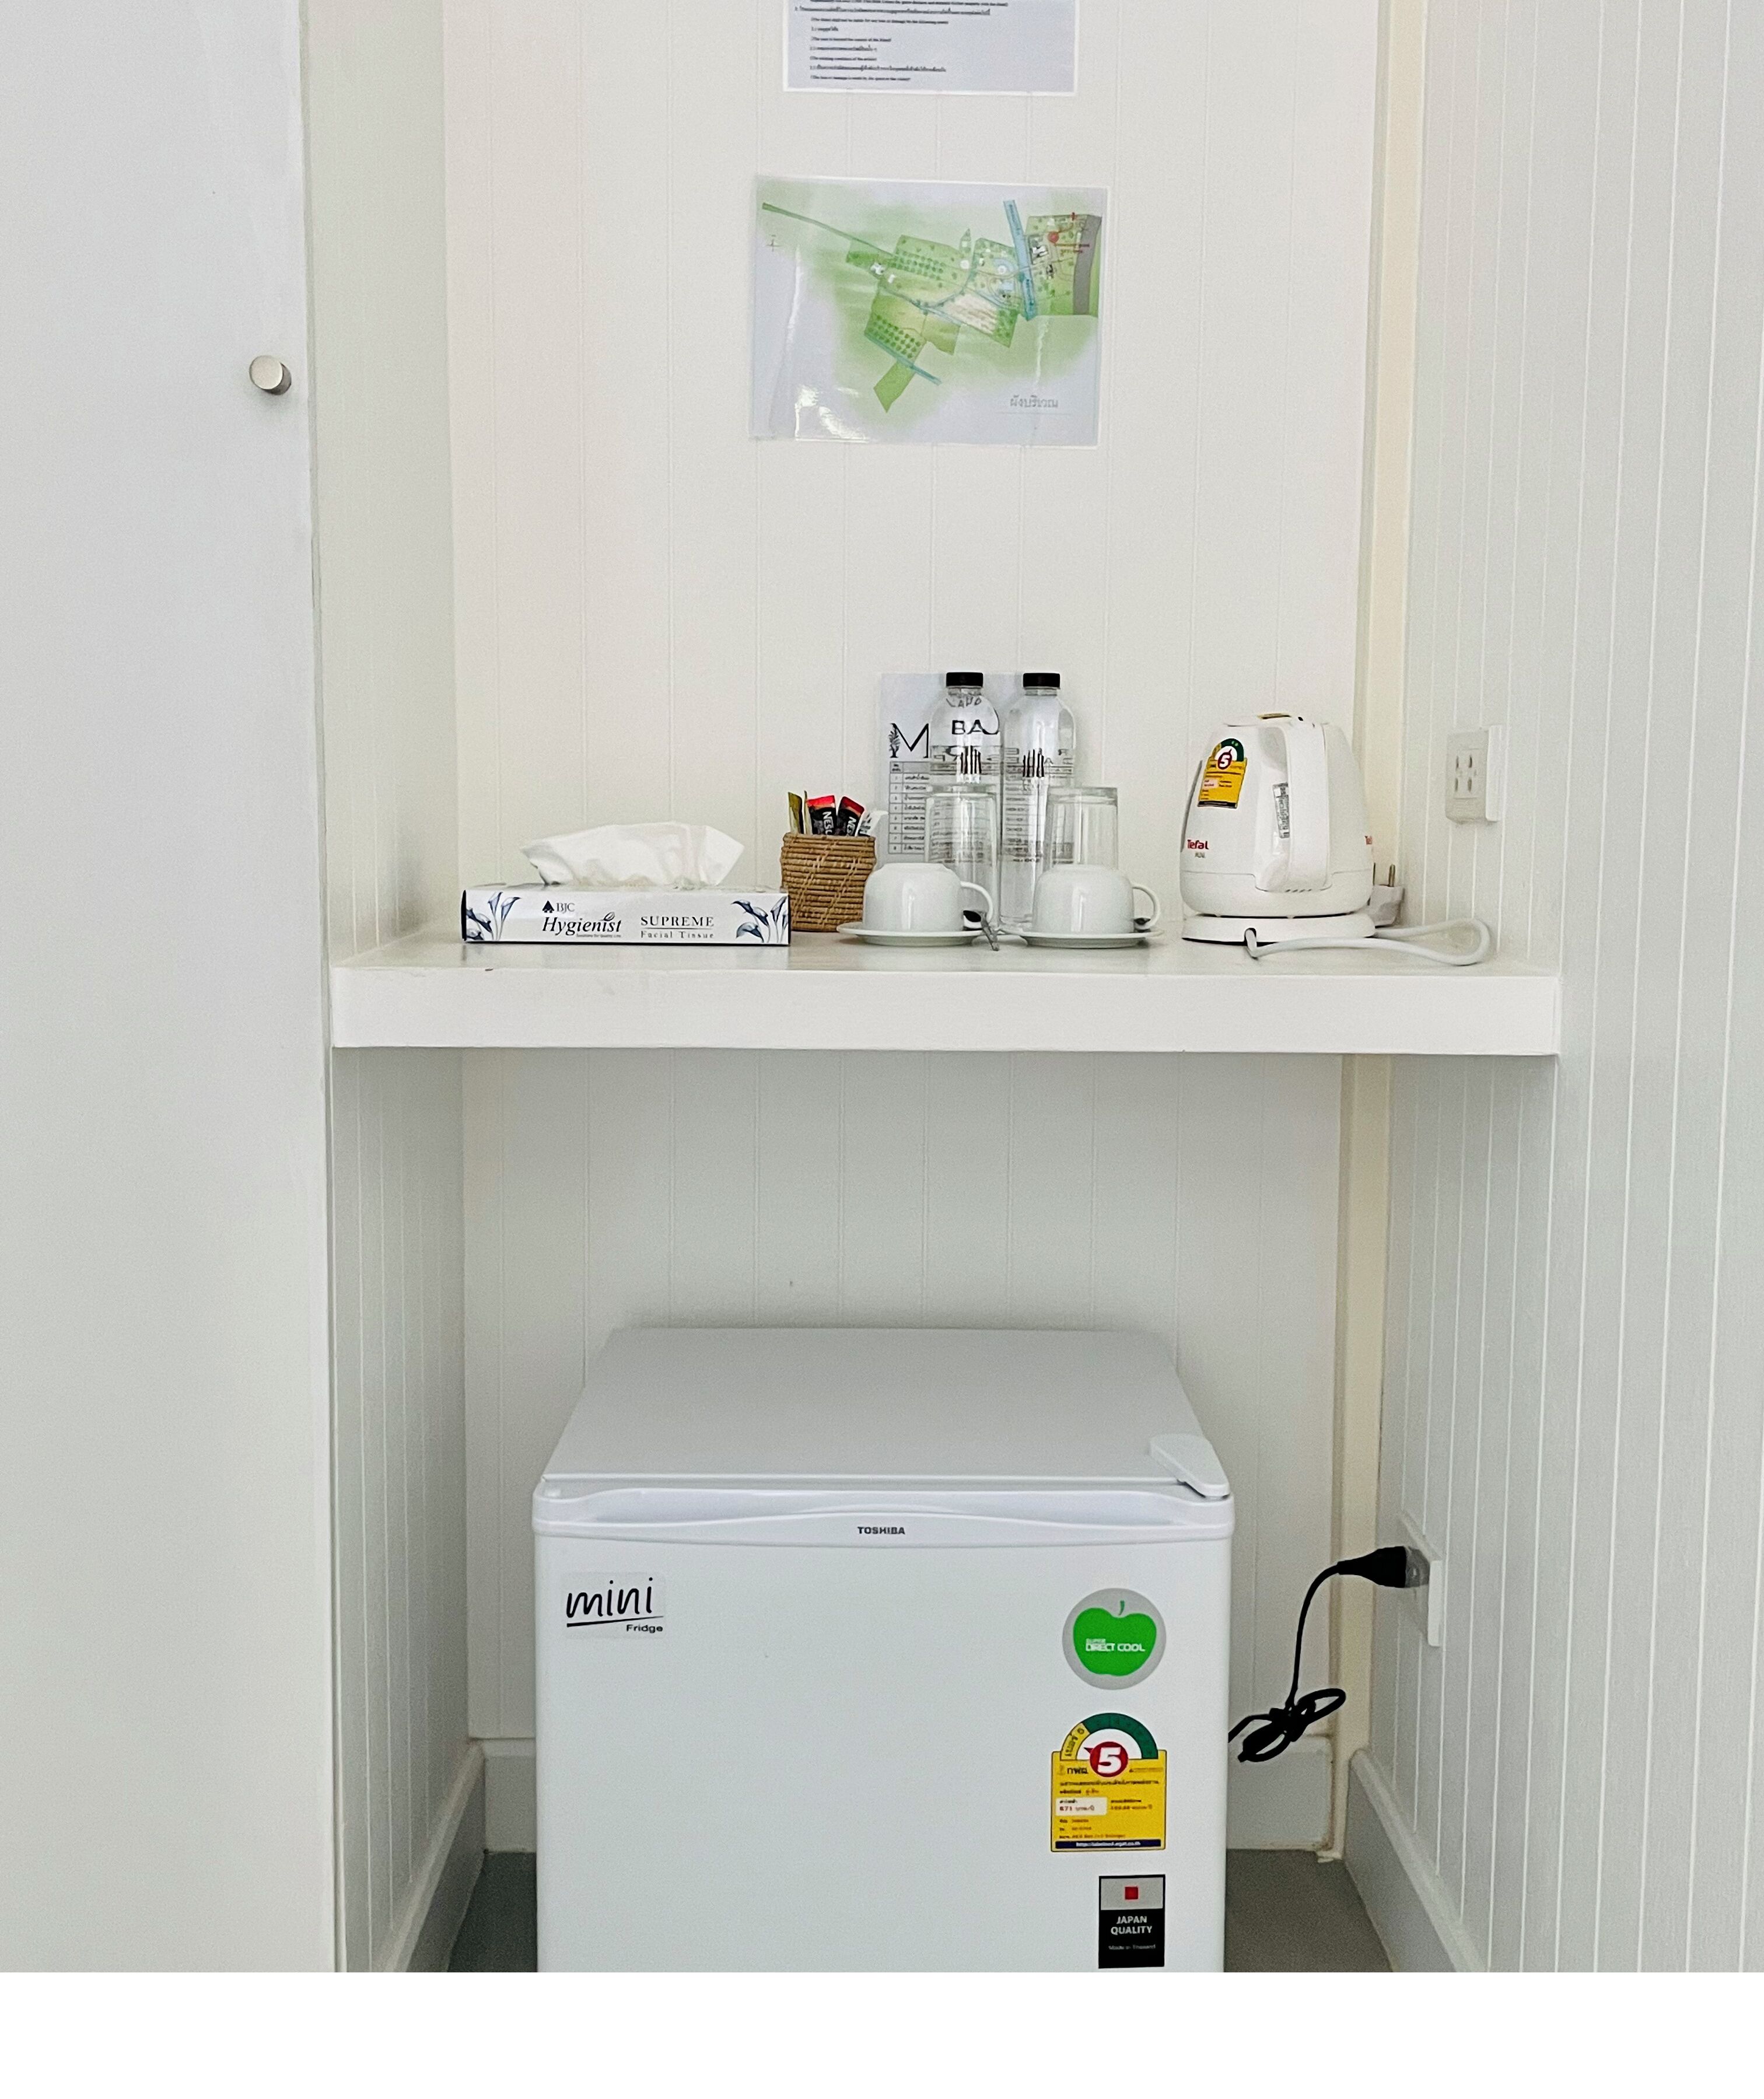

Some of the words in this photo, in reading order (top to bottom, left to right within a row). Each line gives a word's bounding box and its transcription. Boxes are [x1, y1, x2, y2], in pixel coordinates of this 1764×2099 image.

[1187, 839, 1209, 849] Tefal
[556, 902, 575, 914] BJC
[542, 916, 622, 936] Hygienist
[640, 915, 714, 926] SUPREME
[857, 1526, 905, 1535] TOSHIBA
[566, 1577, 653, 1618] mini
[626, 1624, 663, 1633] Fridge
[1117, 1643, 1146, 1652] COOL
[1097, 1746, 1122, 1775] 5
[1116, 1915, 1147, 1925] JAPAN
[1110, 1925, 1153, 1936] QUALITY
